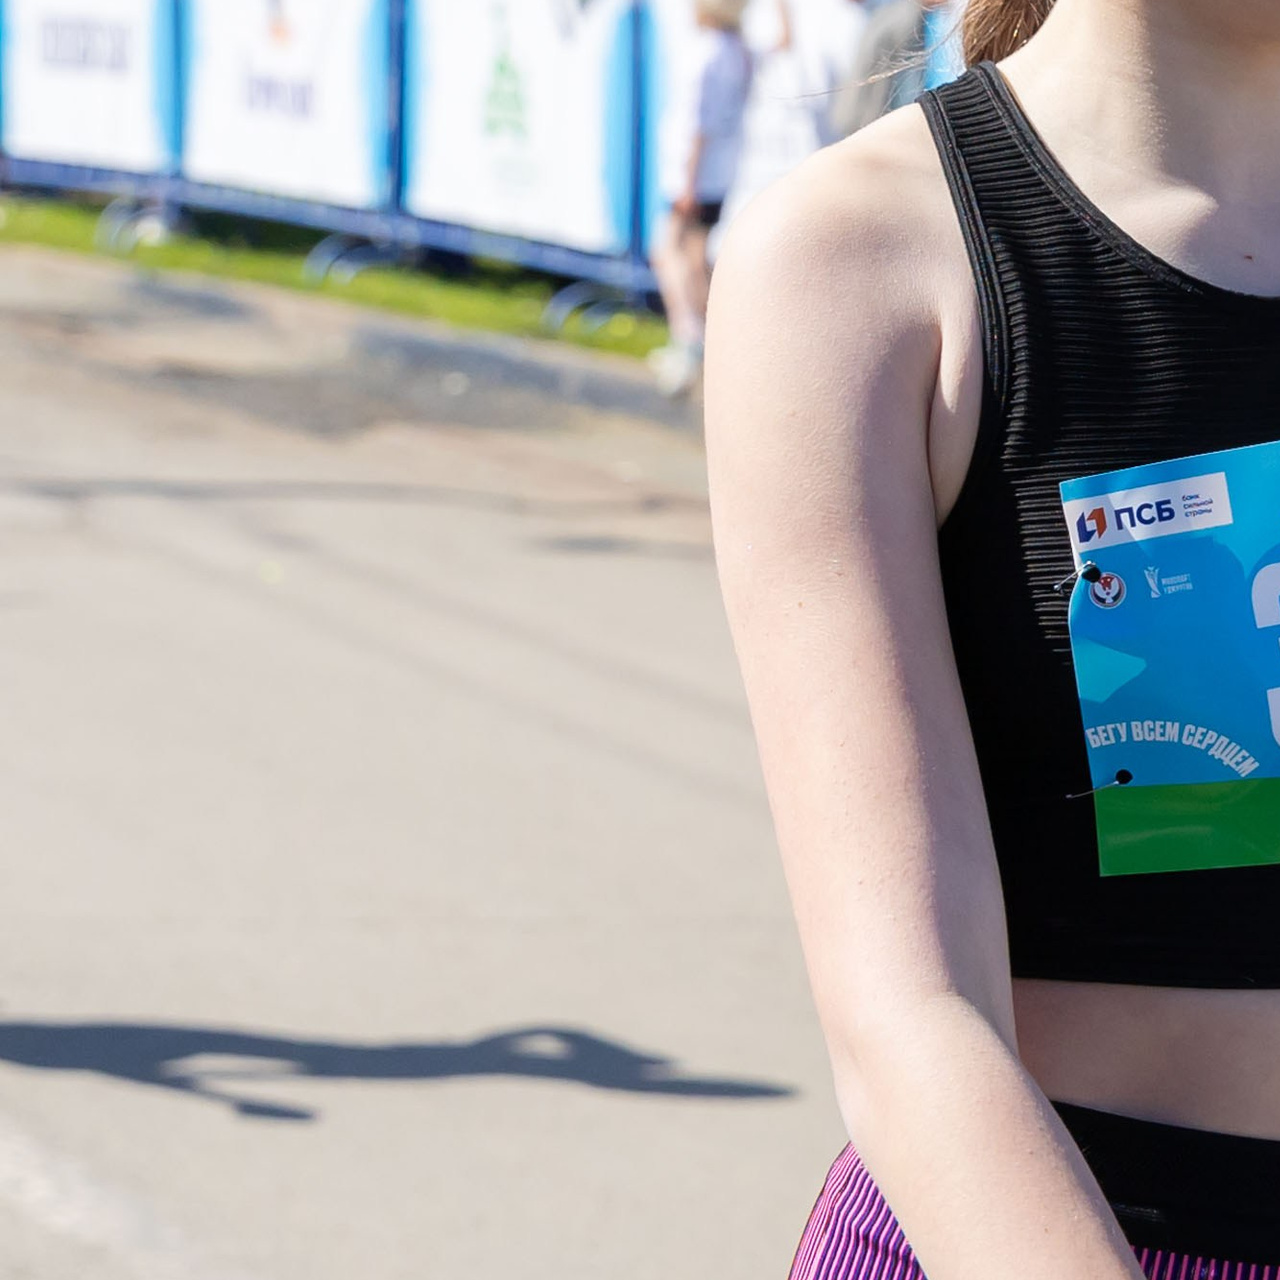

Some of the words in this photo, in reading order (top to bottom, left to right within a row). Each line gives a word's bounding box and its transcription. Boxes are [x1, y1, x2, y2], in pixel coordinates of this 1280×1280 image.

[1114, 499, 1176, 530] ПСБ
[1085, 721, 1127, 749] БЕГУ
[1130, 720, 1180, 743] ВСЕМ
[1181, 723, 1260, 778] СЕРДЦЕМ
